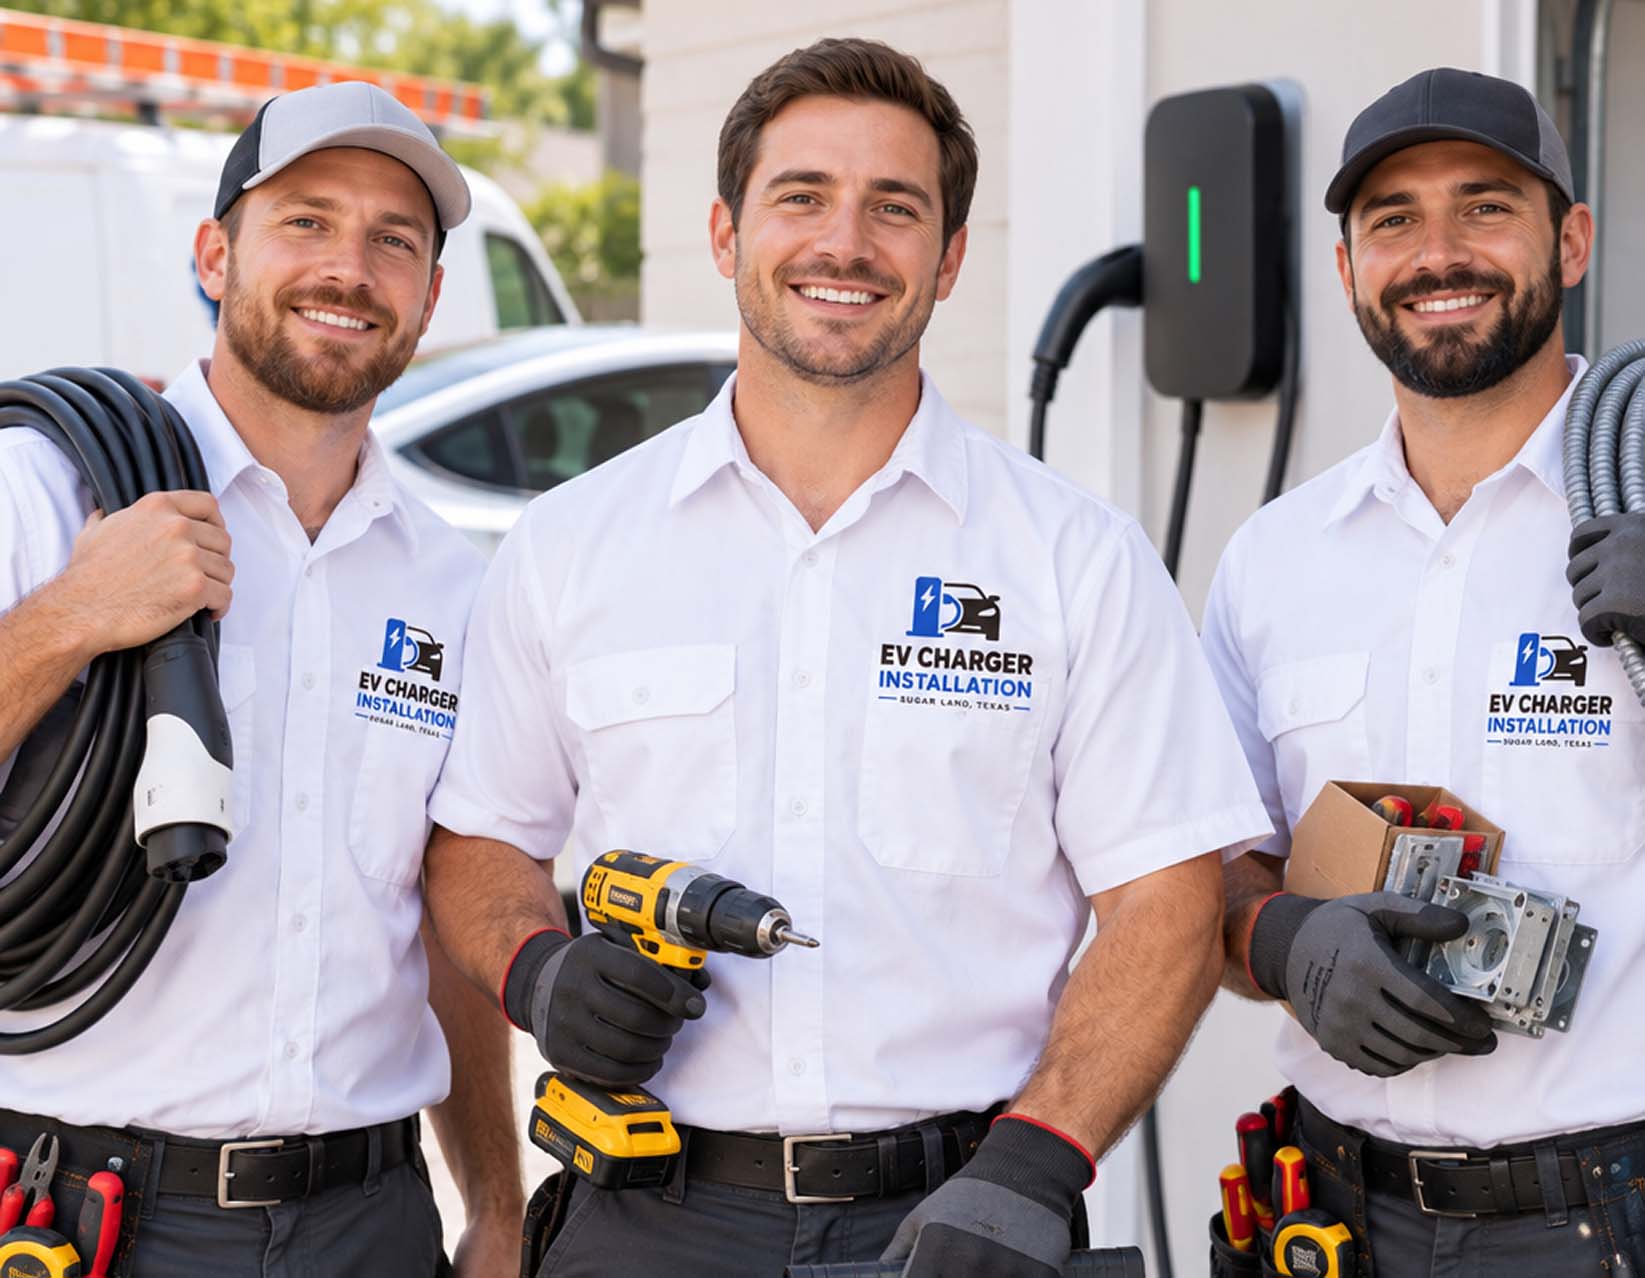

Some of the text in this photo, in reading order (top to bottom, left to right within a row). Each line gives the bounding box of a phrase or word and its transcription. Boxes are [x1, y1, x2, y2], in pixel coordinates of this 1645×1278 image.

[880, 643, 1033, 675] EV CHARGER
[359, 671, 458, 712] EV CHARGER
[879, 670, 1032, 698] INSTALLATION
[356, 692, 456, 729] INSTALLATION
[900, 695, 936, 705] SUGAR
[977, 701, 1011, 712] TEXAS
[1489, 694, 1613, 715] EV CHARGER
[1488, 717, 1611, 735] INSTALLATION
